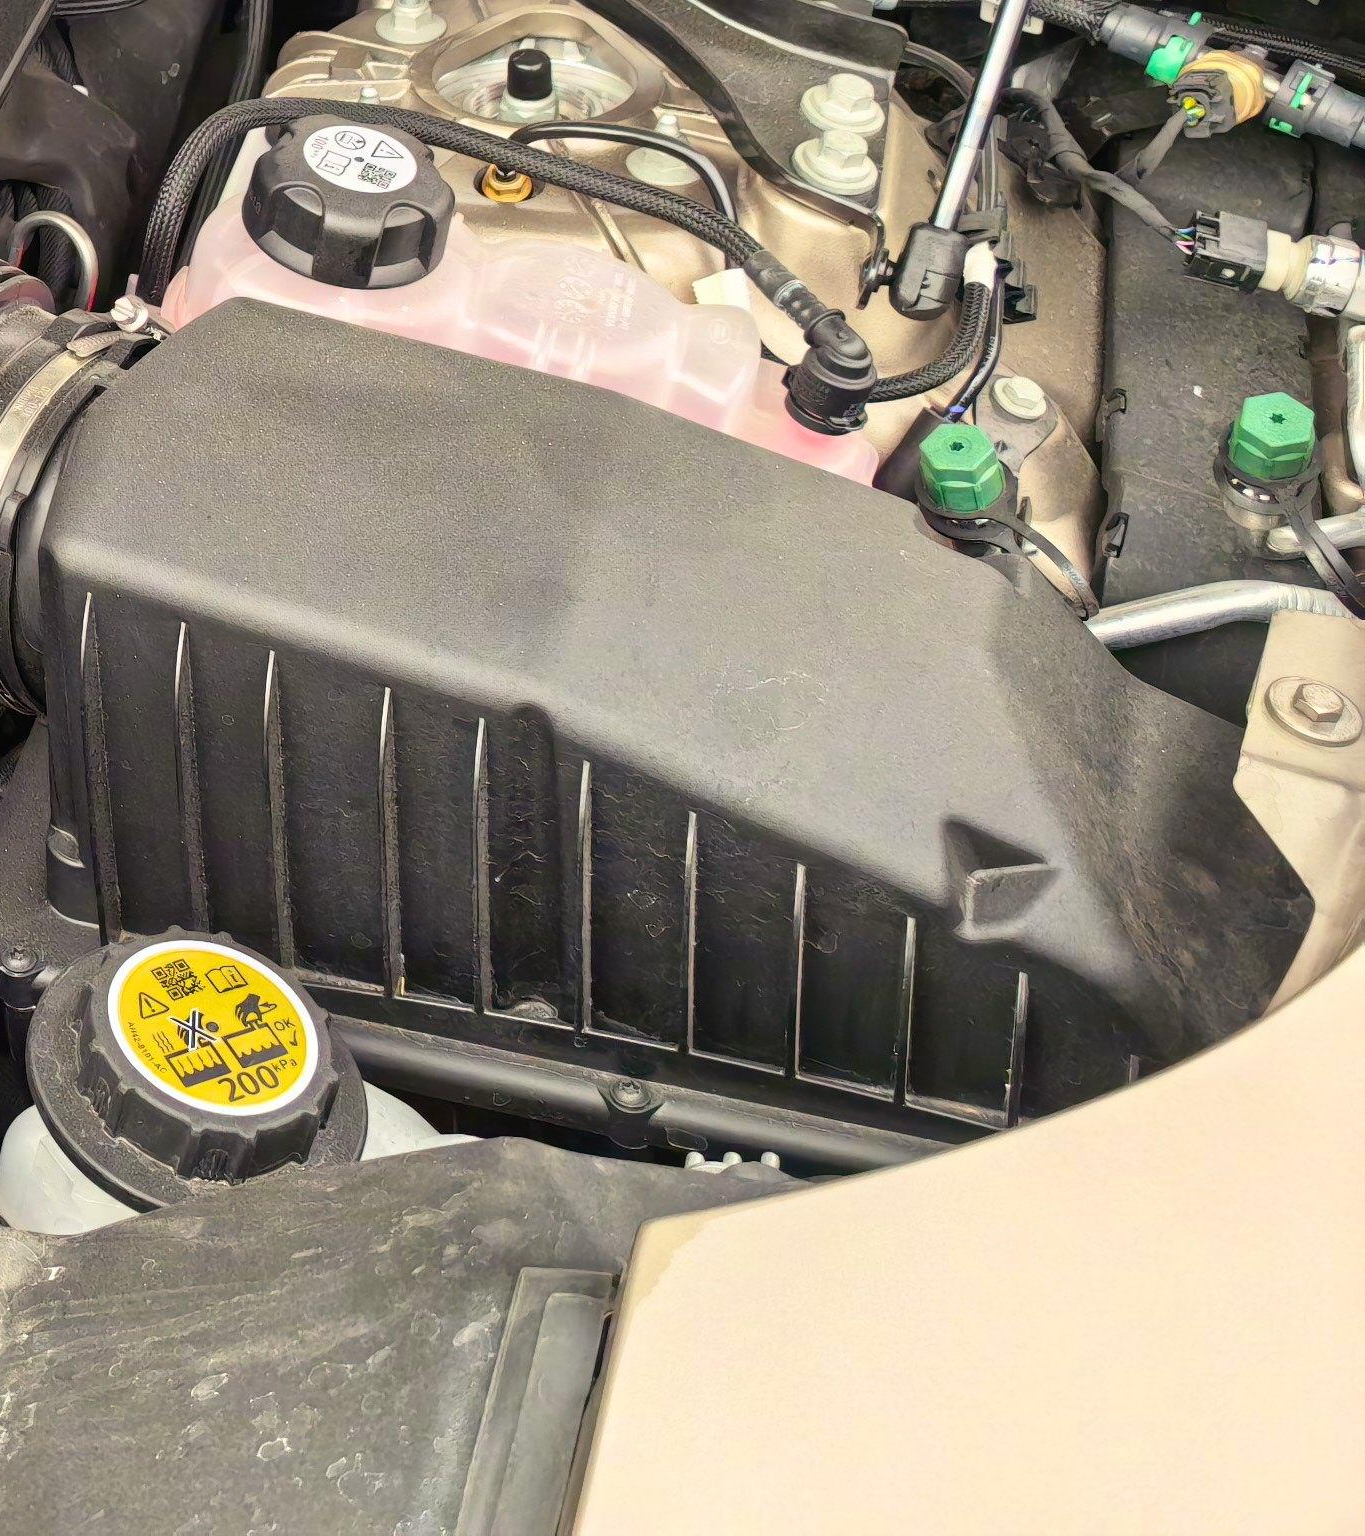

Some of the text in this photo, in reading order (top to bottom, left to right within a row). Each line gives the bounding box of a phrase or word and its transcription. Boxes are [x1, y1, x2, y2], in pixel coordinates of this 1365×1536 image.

[273, 1017, 296, 1033] OK
[218, 1058, 298, 1103] 200 kPa
